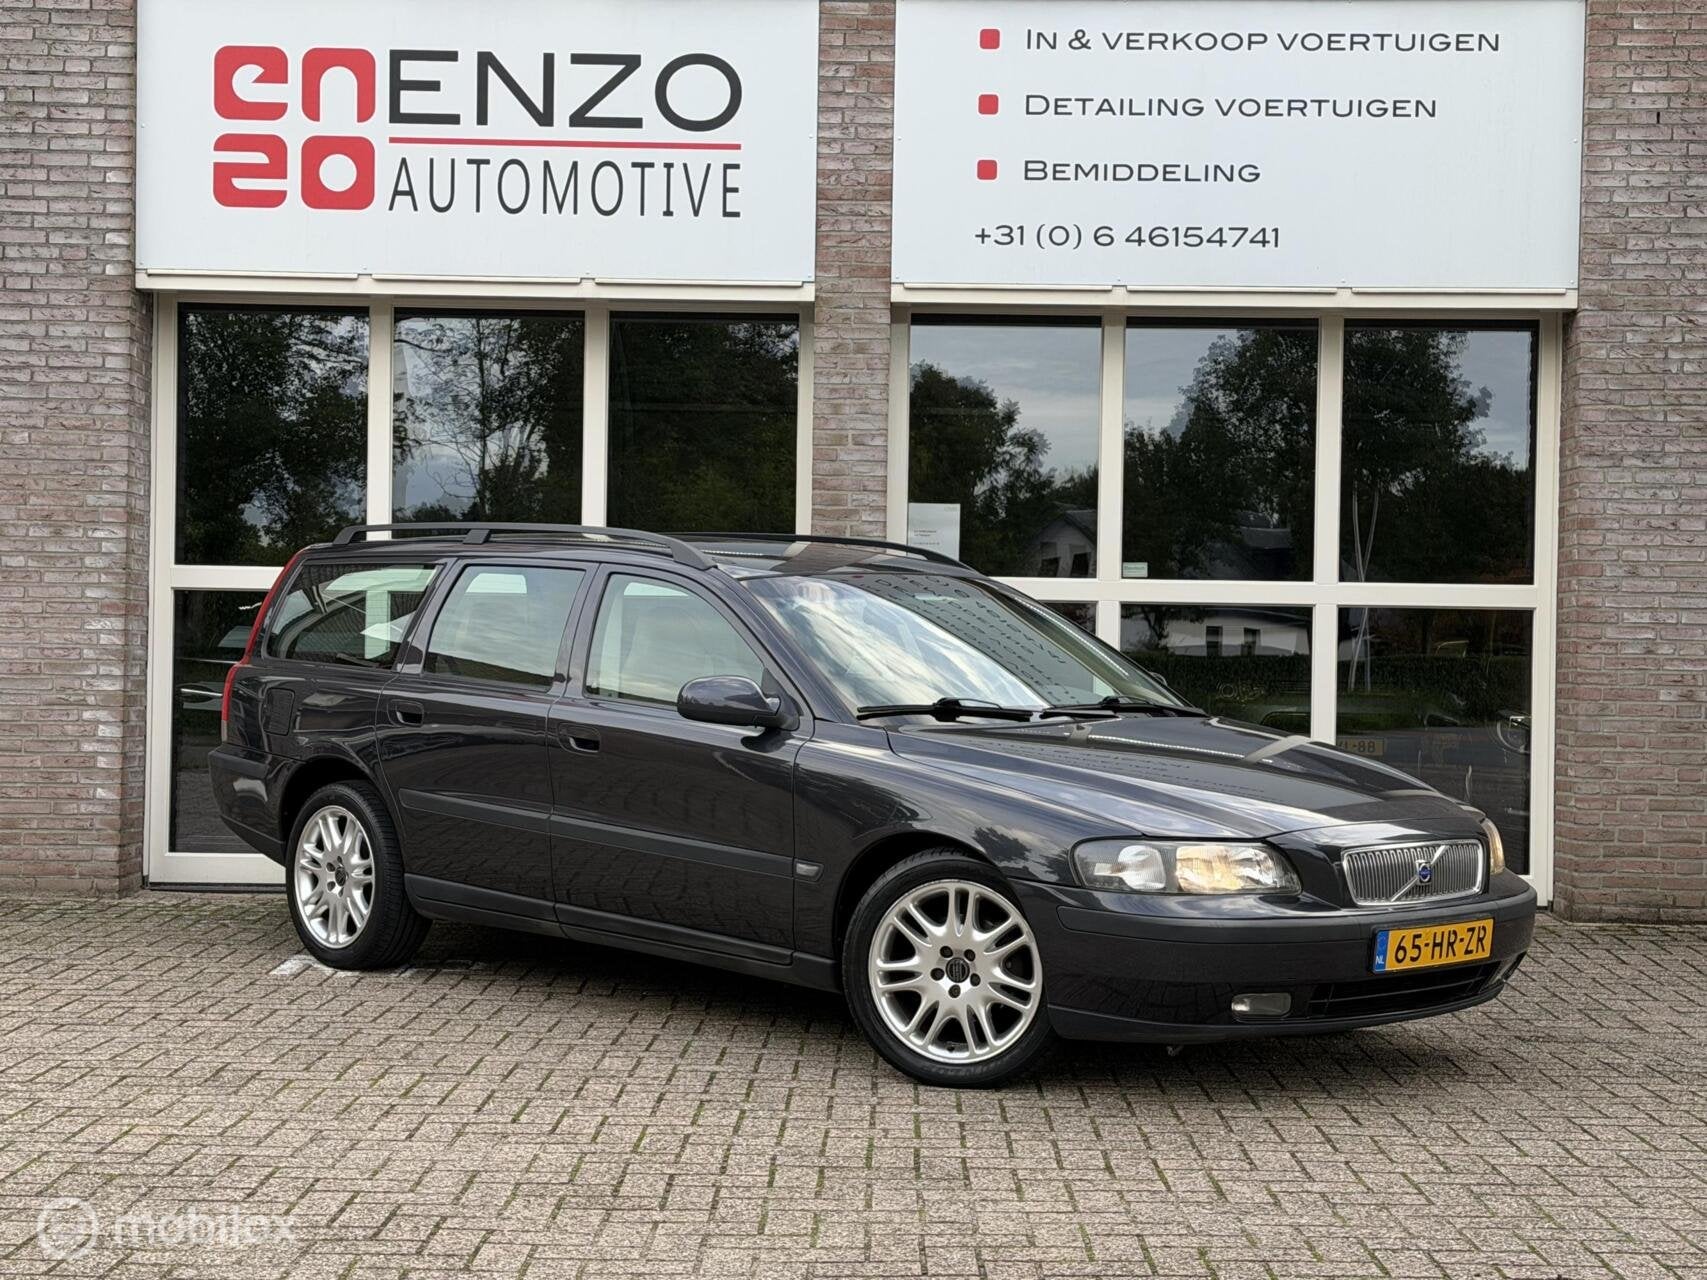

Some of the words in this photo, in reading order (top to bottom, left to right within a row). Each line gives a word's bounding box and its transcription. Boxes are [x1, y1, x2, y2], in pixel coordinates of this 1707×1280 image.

[1027, 28, 1057, 50] IN
[1068, 29, 1092, 51] &
[1102, 31, 1268, 51] VERKOOP
[1276, 32, 1499, 52] VOERTUIGEN
[388, 49, 743, 132] ENZO
[1025, 94, 1205, 117] DETAILING
[1214, 98, 1436, 118] VOERTUIGEN
[1024, 160, 1261, 183] BEMIDDELING
[388, 157, 741, 218] AUTOMOTIVE
[974, 224, 1025, 246] +31
[1036, 223, 1082, 250] (0)
[1093, 225, 1115, 247] 6
[1124, 226, 1279, 248] 46154741
[1375, 954, 1385, 965] NL
[1395, 925, 1487, 963] 65-HR-ZR
